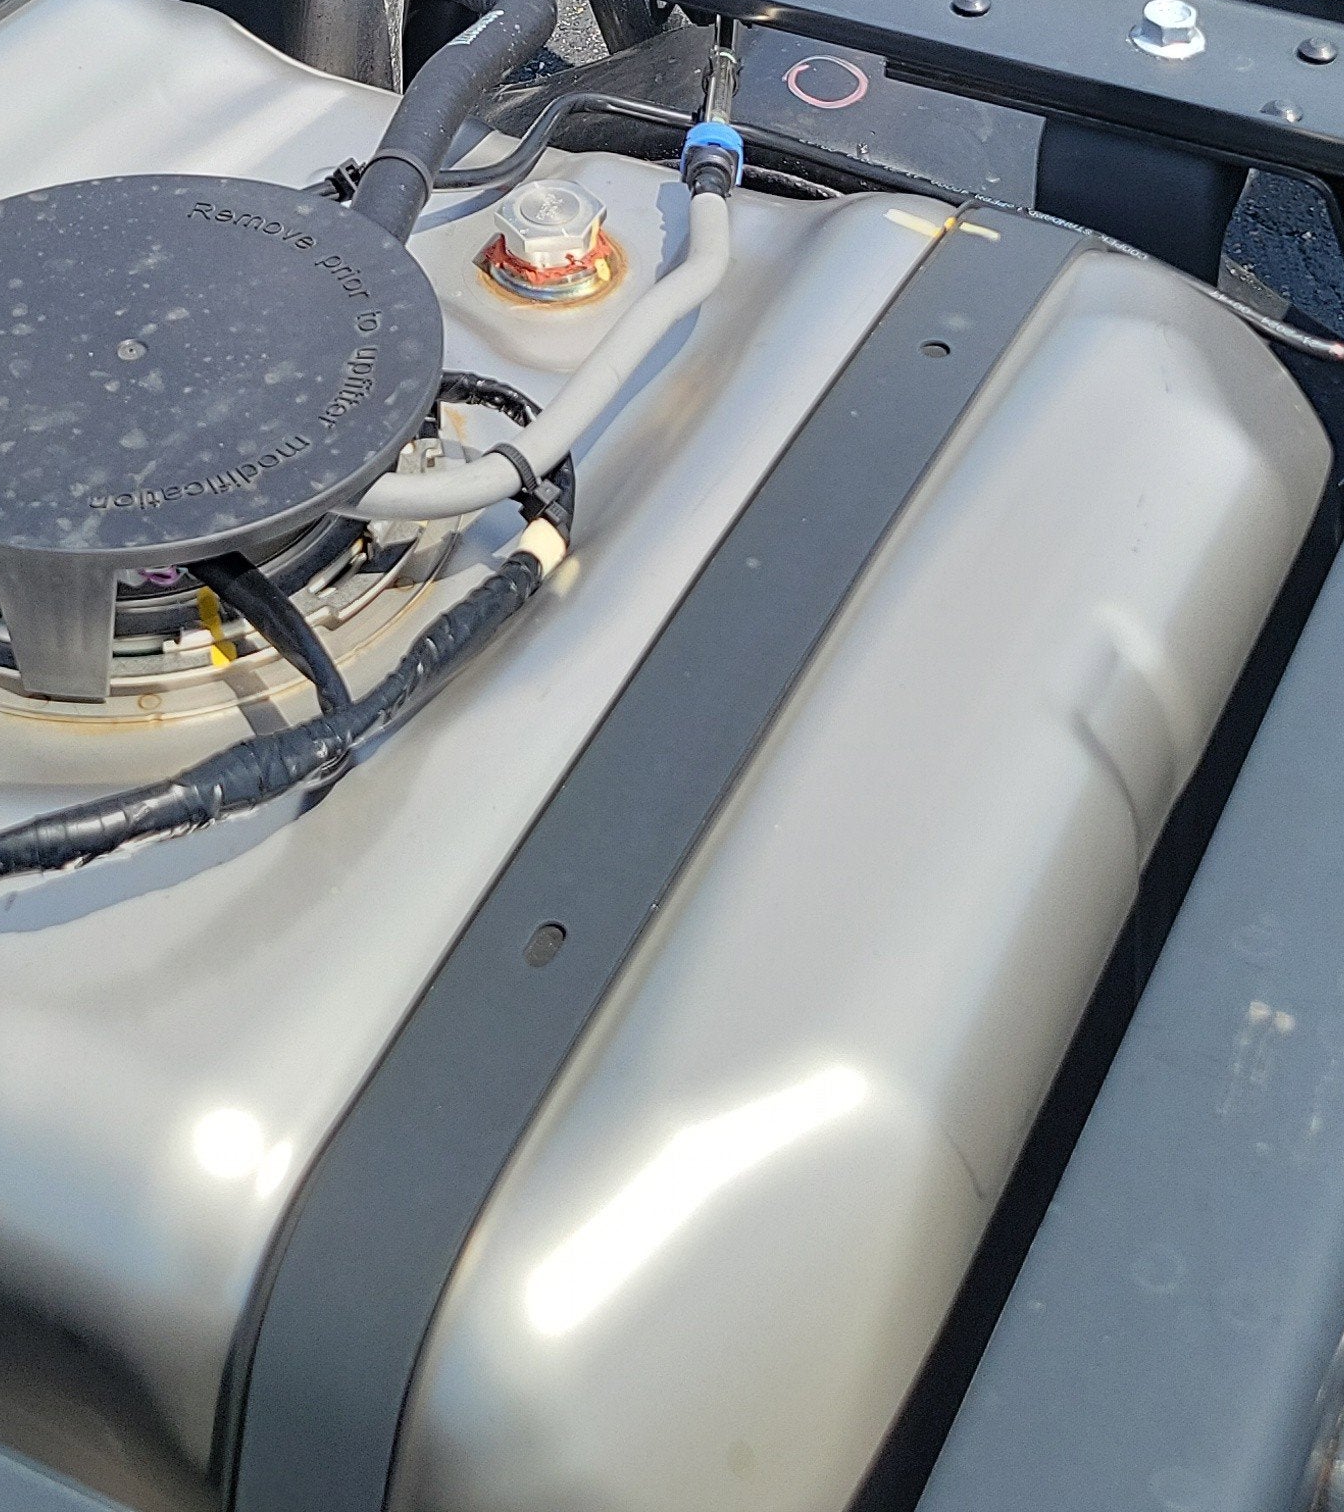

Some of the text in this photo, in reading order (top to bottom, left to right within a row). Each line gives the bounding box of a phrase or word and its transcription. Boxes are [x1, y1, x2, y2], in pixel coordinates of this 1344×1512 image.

[88, 201, 381, 509] Remove prior to upfitter modification
